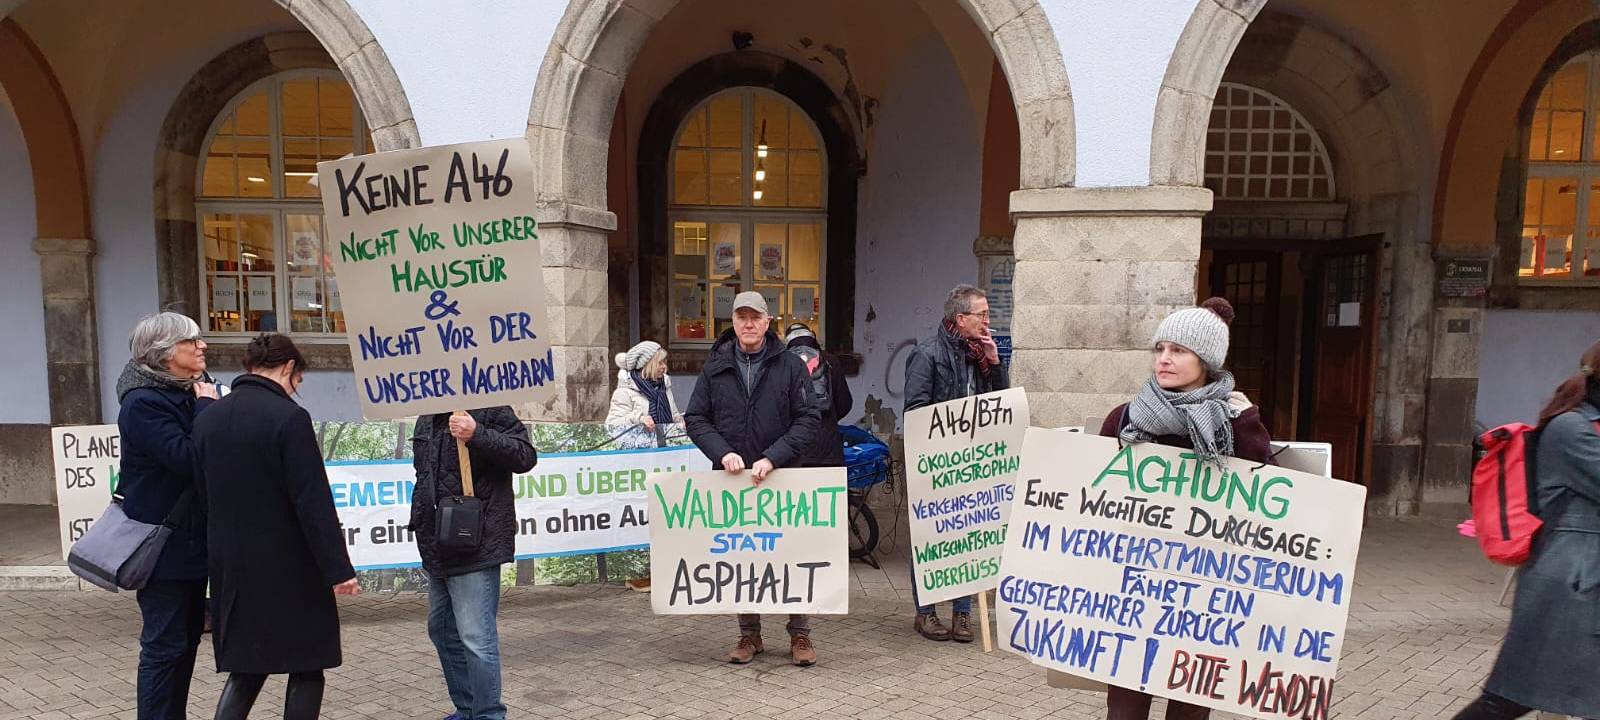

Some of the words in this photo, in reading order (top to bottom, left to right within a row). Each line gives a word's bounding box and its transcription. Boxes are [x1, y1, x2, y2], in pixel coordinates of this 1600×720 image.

[335, 161, 434, 217] KEINE
[444, 148, 513, 204] A46
[340, 229, 399, 263] NICHT
[409, 223, 445, 254] VOR
[453, 215, 539, 248] UNSERER
[391, 254, 508, 293] HAUSTÜR
[424, 289, 462, 321] &
[358, 326, 425, 361] NICHT
[437, 320, 478, 353] VOR
[489, 311, 537, 344] DER
[364, 367, 457, 404] UNSERER
[462, 348, 554, 396] NACHBARN
[928, 396, 1012, 440] A46/B7n
[62, 432, 120, 459] PLANE
[917, 440, 1007, 474] ÖKOLOGISCH
[65, 467, 96, 489] DES
[912, 484, 1015, 520] VERKEHRSPOLITIS
[1091, 445, 1294, 520] ACHTUNG
[546, 508, 611, 534] ohne
[654, 478, 846, 530] WALDERHALT
[935, 506, 1001, 534] UNSINNIG
[1024, 479, 1069, 511] EINE
[1079, 487, 1175, 530] WICHTIGE
[70, 517, 94, 542] IST
[710, 532, 783, 554] STATT
[669, 558, 831, 606] ASPHALT
[1022, 521, 1051, 553] IM
[1060, 526, 1344, 606] VERKEHRTMINISTERIUM
[1121, 566, 1202, 608] FÄHRT
[1208, 587, 1255, 618] EIN
[999, 575, 1146, 629] GEISTERFAHRER
[1153, 605, 1246, 648] ZURÜCK
[1257, 624, 1287, 654] IN
[1294, 628, 1335, 663] DIE
[1167, 649, 1231, 700] BITTE
[1237, 659, 1335, 720] WENDEN
